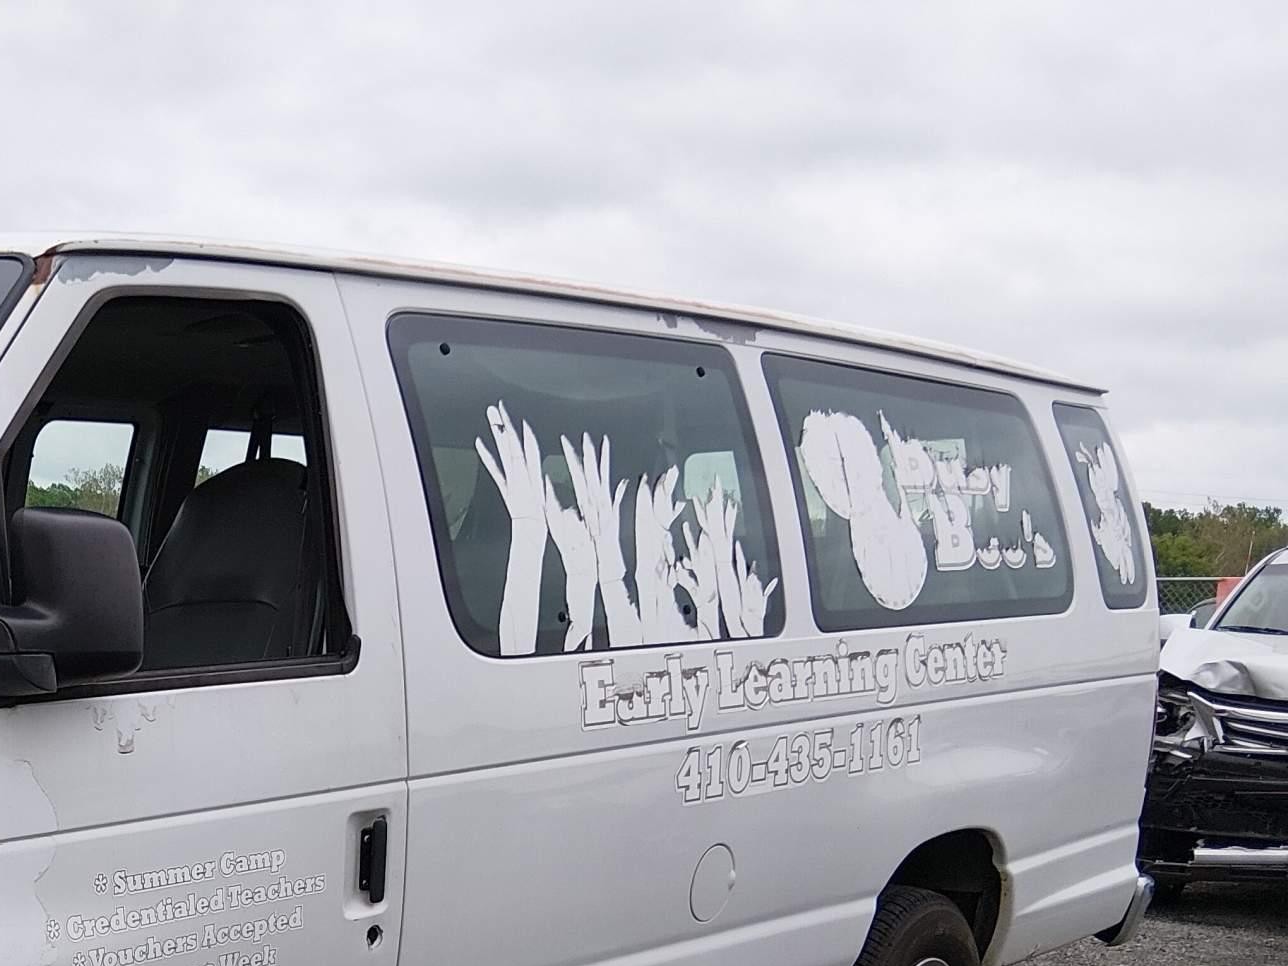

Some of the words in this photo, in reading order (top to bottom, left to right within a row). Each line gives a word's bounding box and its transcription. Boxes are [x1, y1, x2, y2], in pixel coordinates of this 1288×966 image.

[579, 652, 709, 731] Early
[713, 639, 899, 712] Learning
[904, 632, 1008, 687] Center
[675, 714, 921, 803] 410-435-1161
[113, 860, 215, 895] Summer
[219, 849, 286, 876] Camp
[66, 889, 224, 941] Credentialed
[227, 873, 325, 909] Teachers
[201, 906, 304, 947] Accepted
